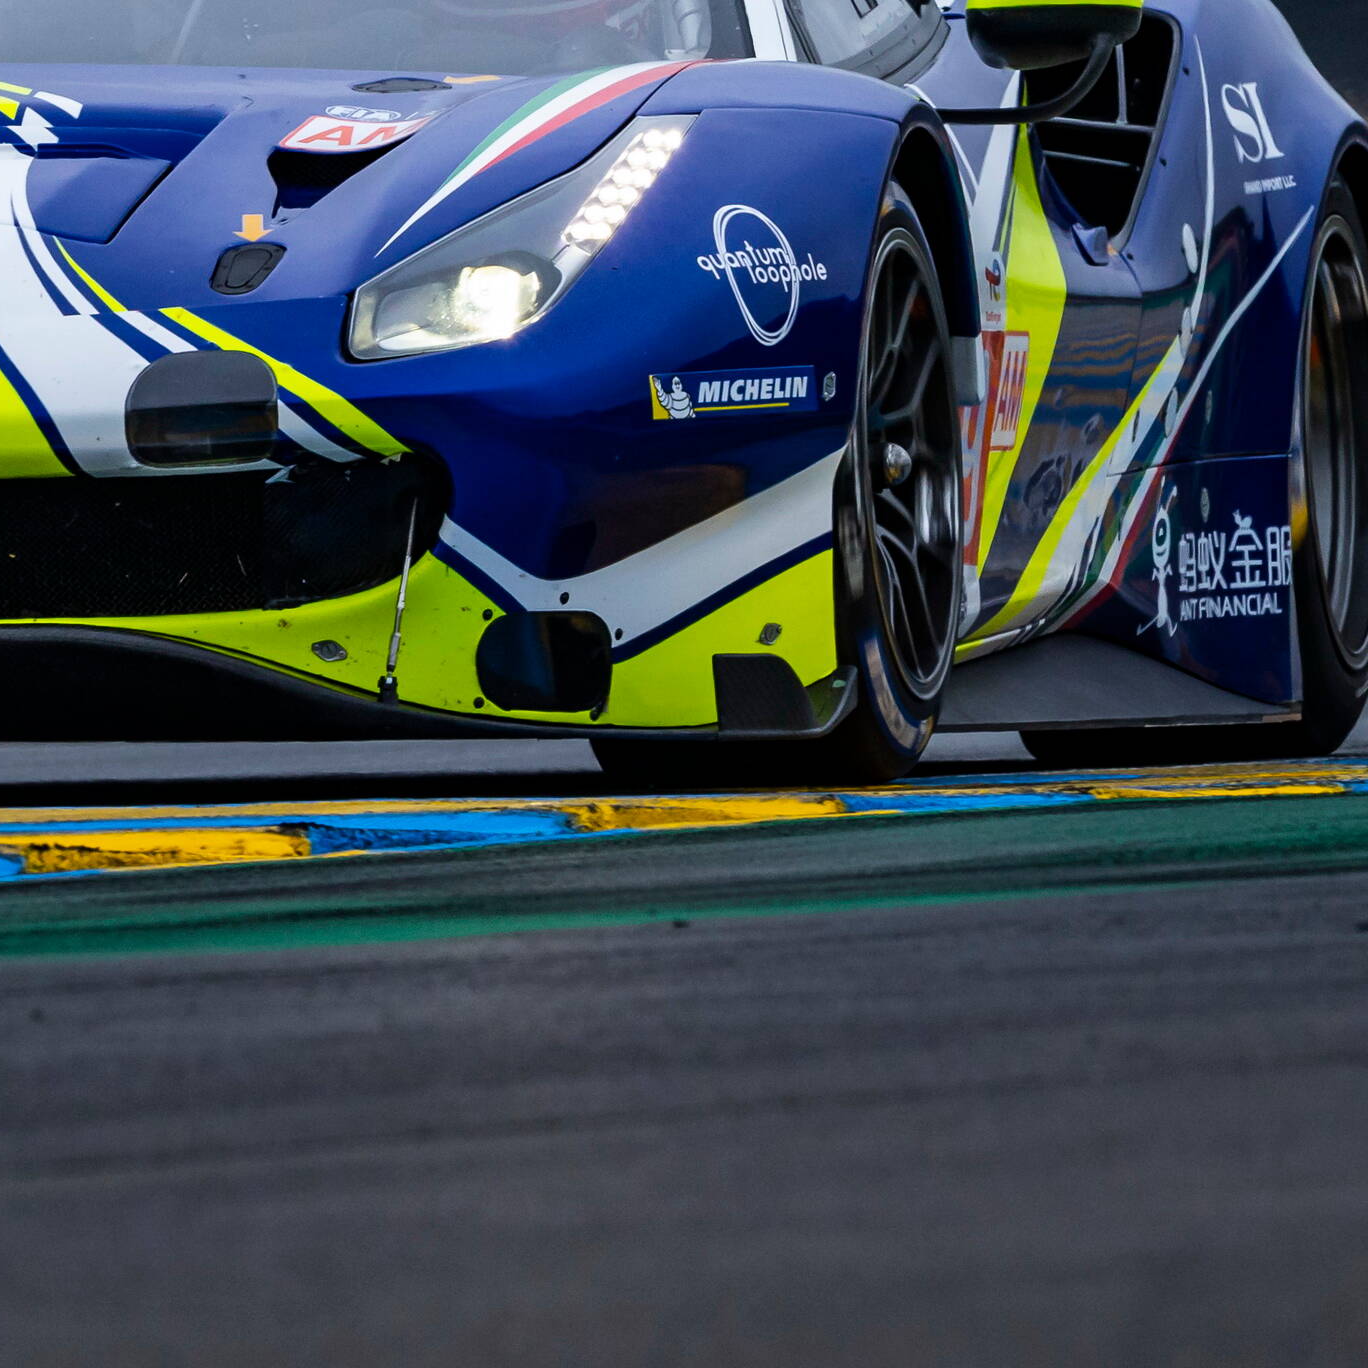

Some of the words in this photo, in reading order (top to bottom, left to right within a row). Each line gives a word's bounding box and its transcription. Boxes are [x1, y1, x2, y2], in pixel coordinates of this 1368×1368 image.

[697, 240, 790, 280] quantum
[743, 253, 828, 293] loophole
[698, 376, 808, 403] MICHELIN
[1178, 510, 1292, 592] 蚂蚁金服
[1179, 598, 1198, 621] ANT
[1199, 592, 1283, 619] FINANCIAL
